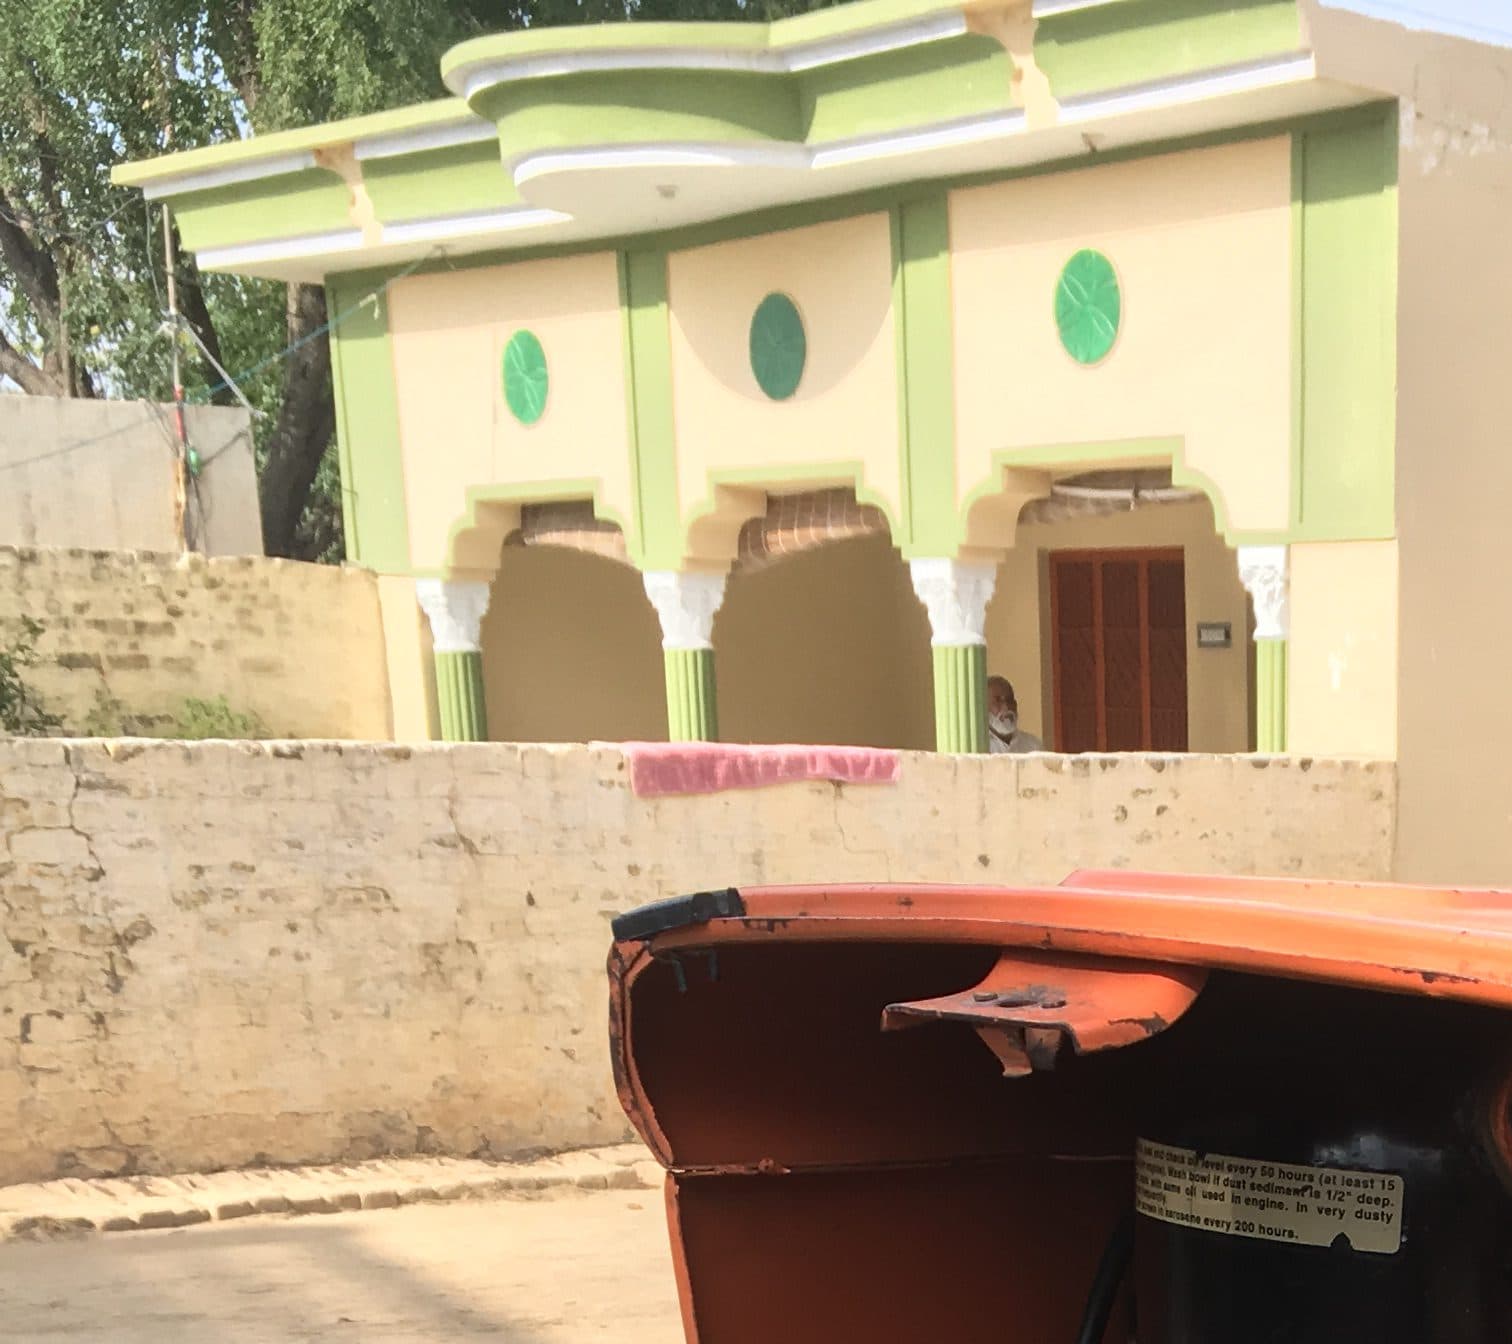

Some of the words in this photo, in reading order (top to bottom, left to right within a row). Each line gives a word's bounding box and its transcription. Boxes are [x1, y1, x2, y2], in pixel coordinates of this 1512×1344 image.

[1188, 1171, 1211, 1185] bowl
[1222, 1176, 1246, 1190] dust
[1356, 1193, 1395, 1209] deep.
[1201, 1159, 1225, 1172] level
[1227, 1163, 1257, 1178] every
[1260, 1165, 1275, 1178] 50
[1278, 1168, 1314, 1183] hours
[1319, 1172, 1337, 1186] (at
[1341, 1175, 1375, 1190] least
[1380, 1179, 1396, 1191] 15
[1201, 1189, 1225, 1202] used
[1244, 1196, 1289, 1211] engine.
[1296, 1201, 1308, 1213] In
[1316, 1205, 1345, 1220] very
[1354, 1208, 1393, 1225] dusty
[1203, 1216, 1231, 1232] every
[1234, 1219, 1255, 1233] 200
[1258, 1223, 1299, 1239] hours.
